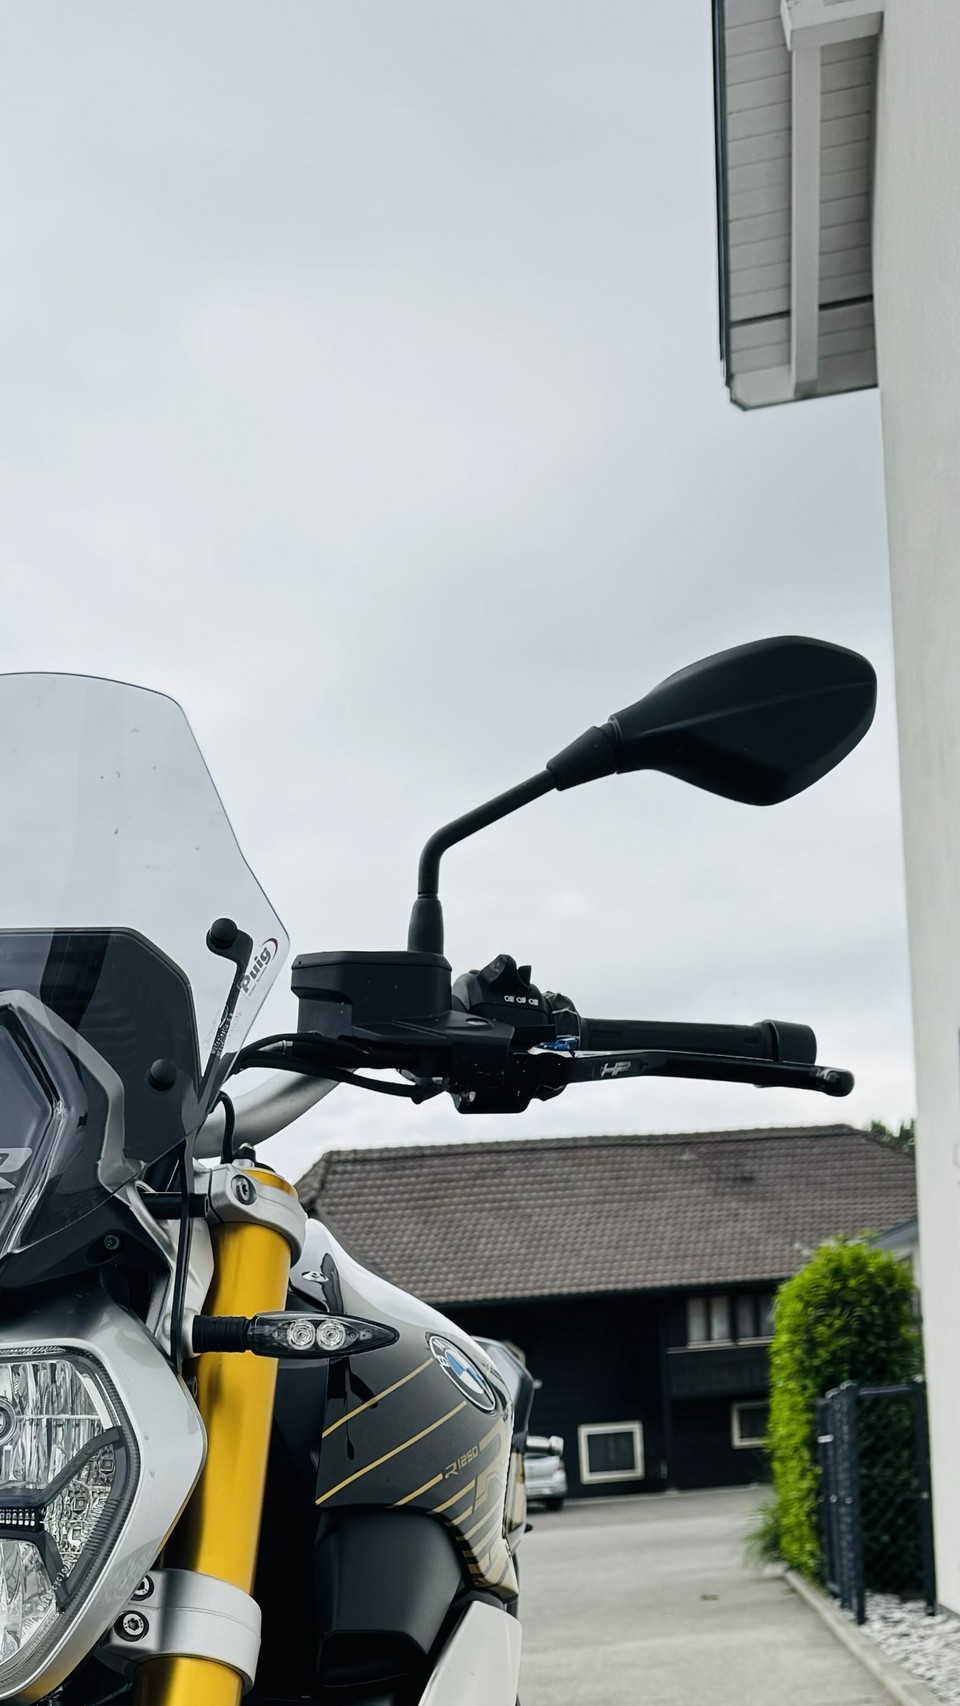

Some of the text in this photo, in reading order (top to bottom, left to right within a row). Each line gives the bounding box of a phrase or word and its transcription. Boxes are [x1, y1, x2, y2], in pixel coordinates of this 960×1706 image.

[238, 946, 272, 993] Puig
[600, 1061, 631, 1077] HP
[444, 1445, 479, 1480] R1250
